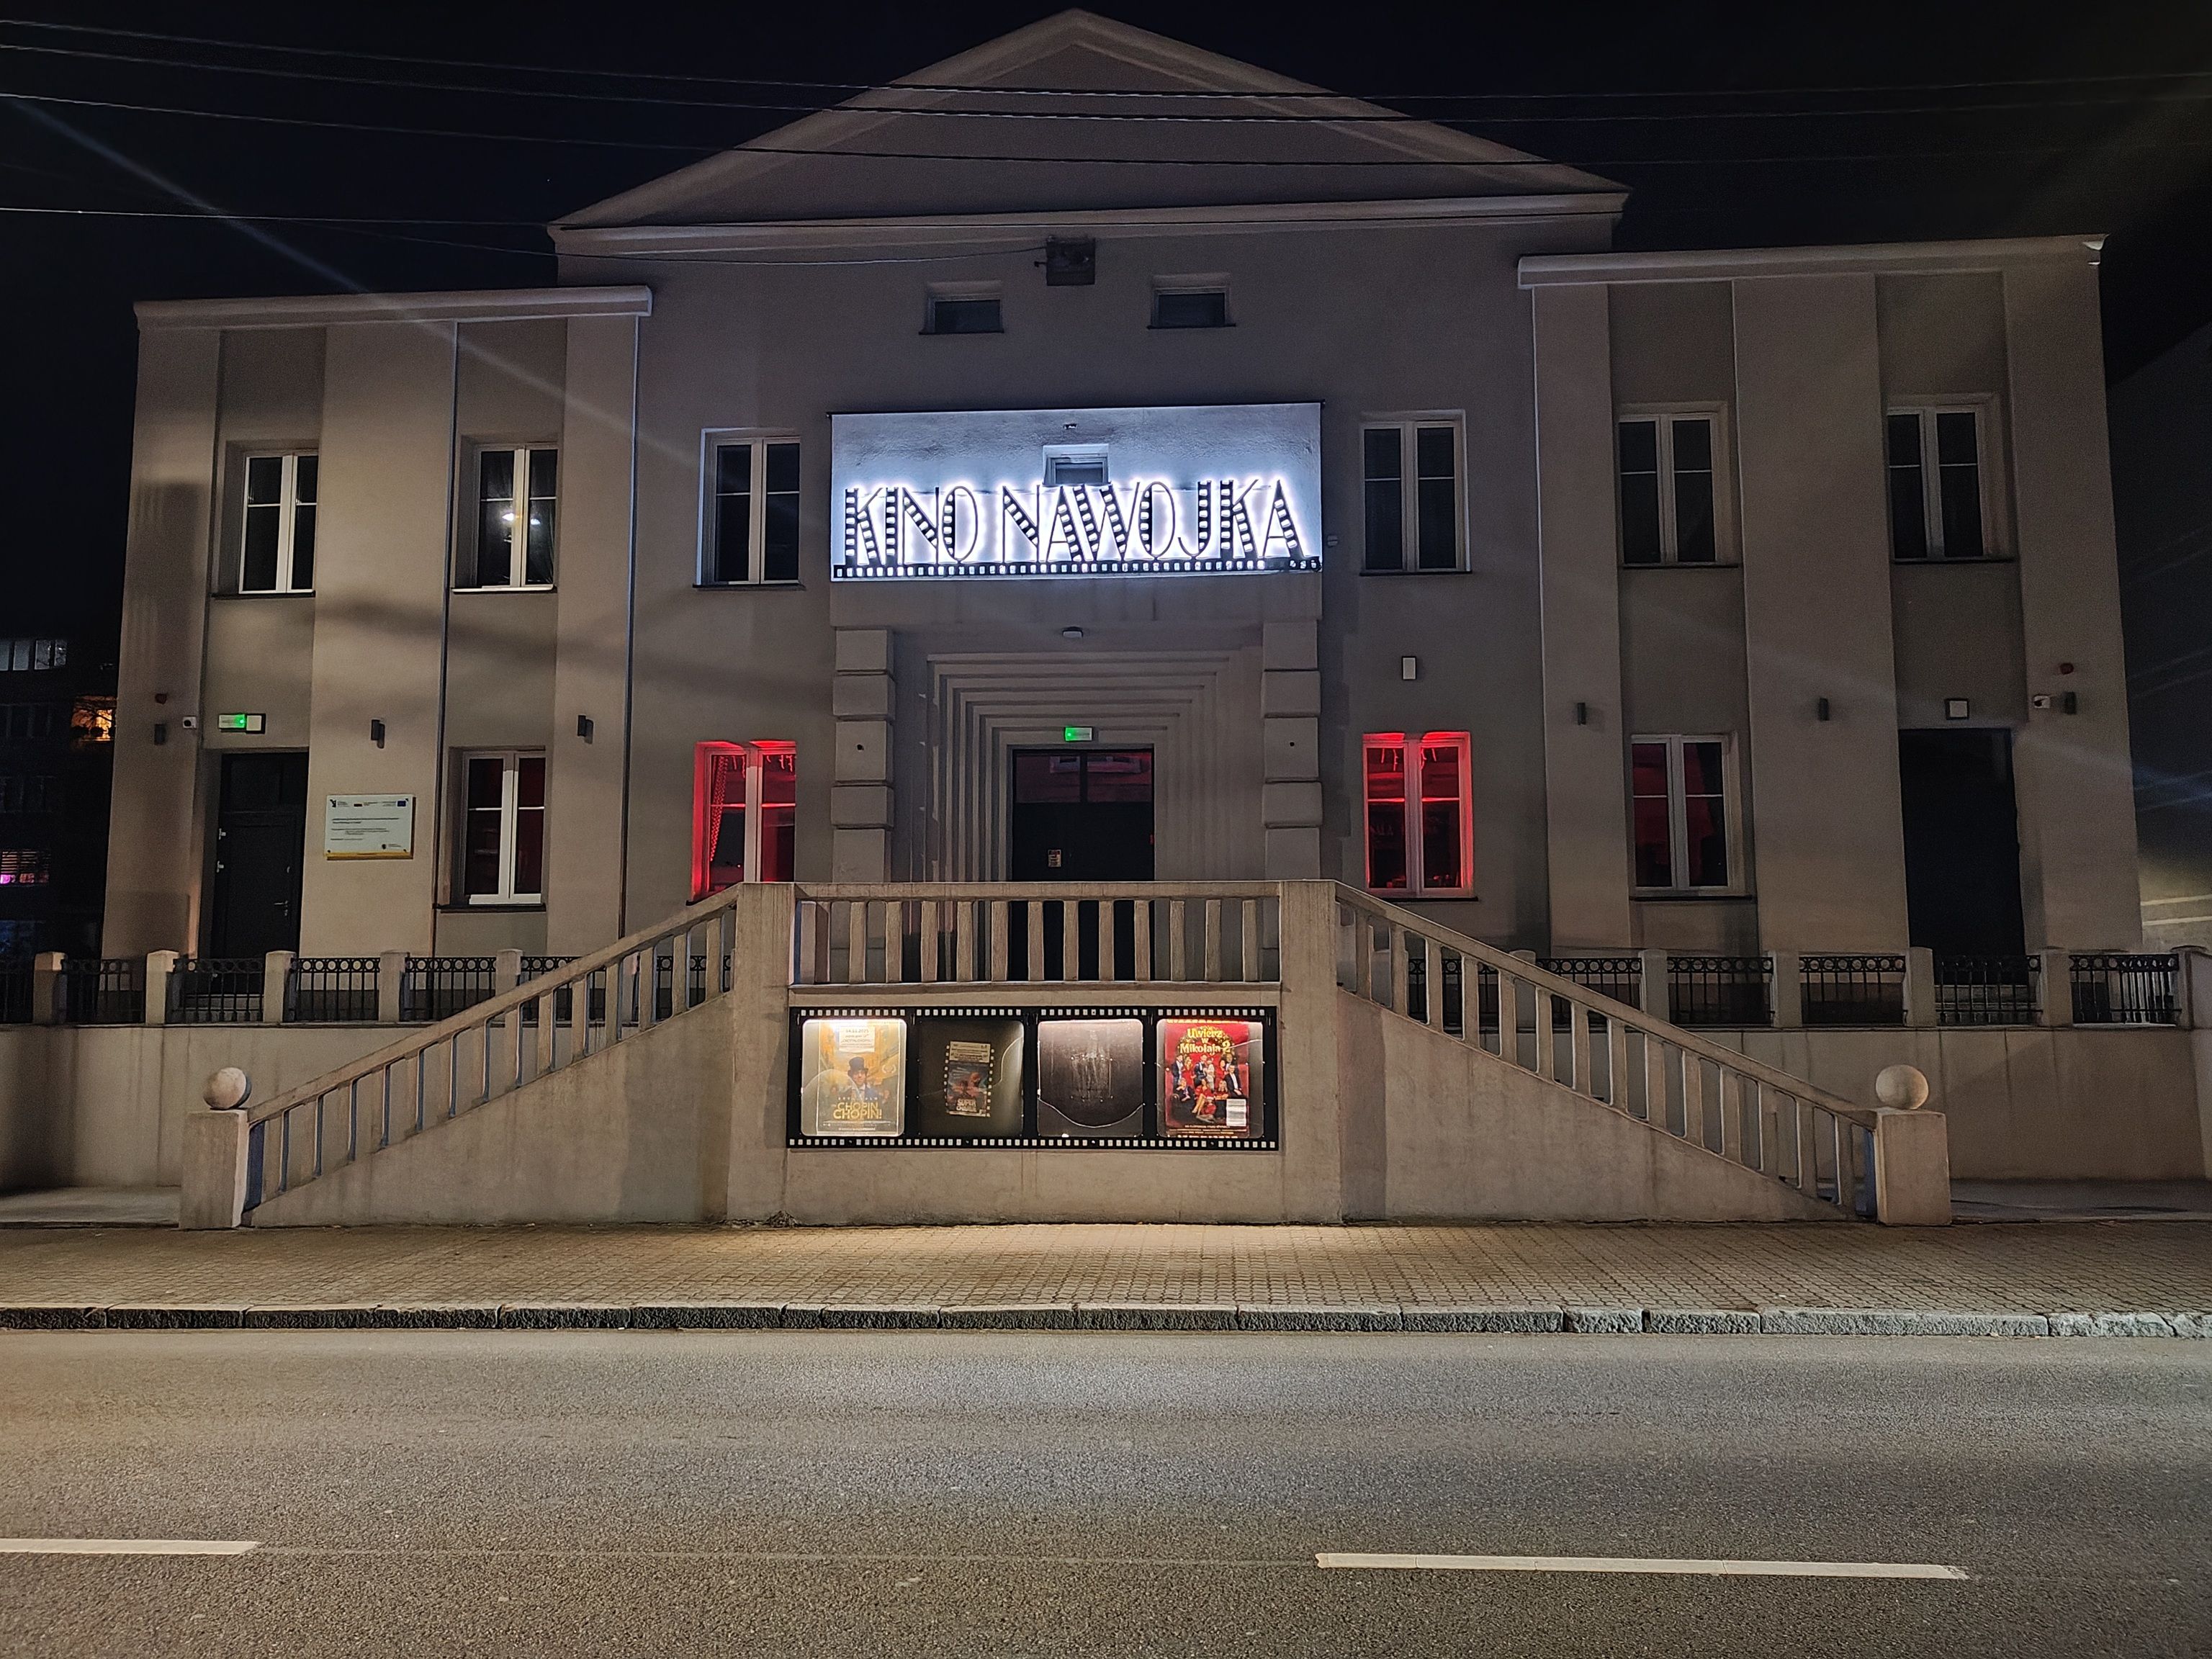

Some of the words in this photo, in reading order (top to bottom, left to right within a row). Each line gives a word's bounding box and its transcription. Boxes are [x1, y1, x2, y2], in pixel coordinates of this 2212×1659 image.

[845, 485, 979, 567] KINO
[1002, 479, 1305, 563] NAWOJKA
[1187, 1028, 1223, 1038] Uwierz
[1179, 1043, 1220, 1056] Mikołaja
[1222, 1040, 1231, 1053] 2
[833, 1109, 883, 1120] CHOPIN!
